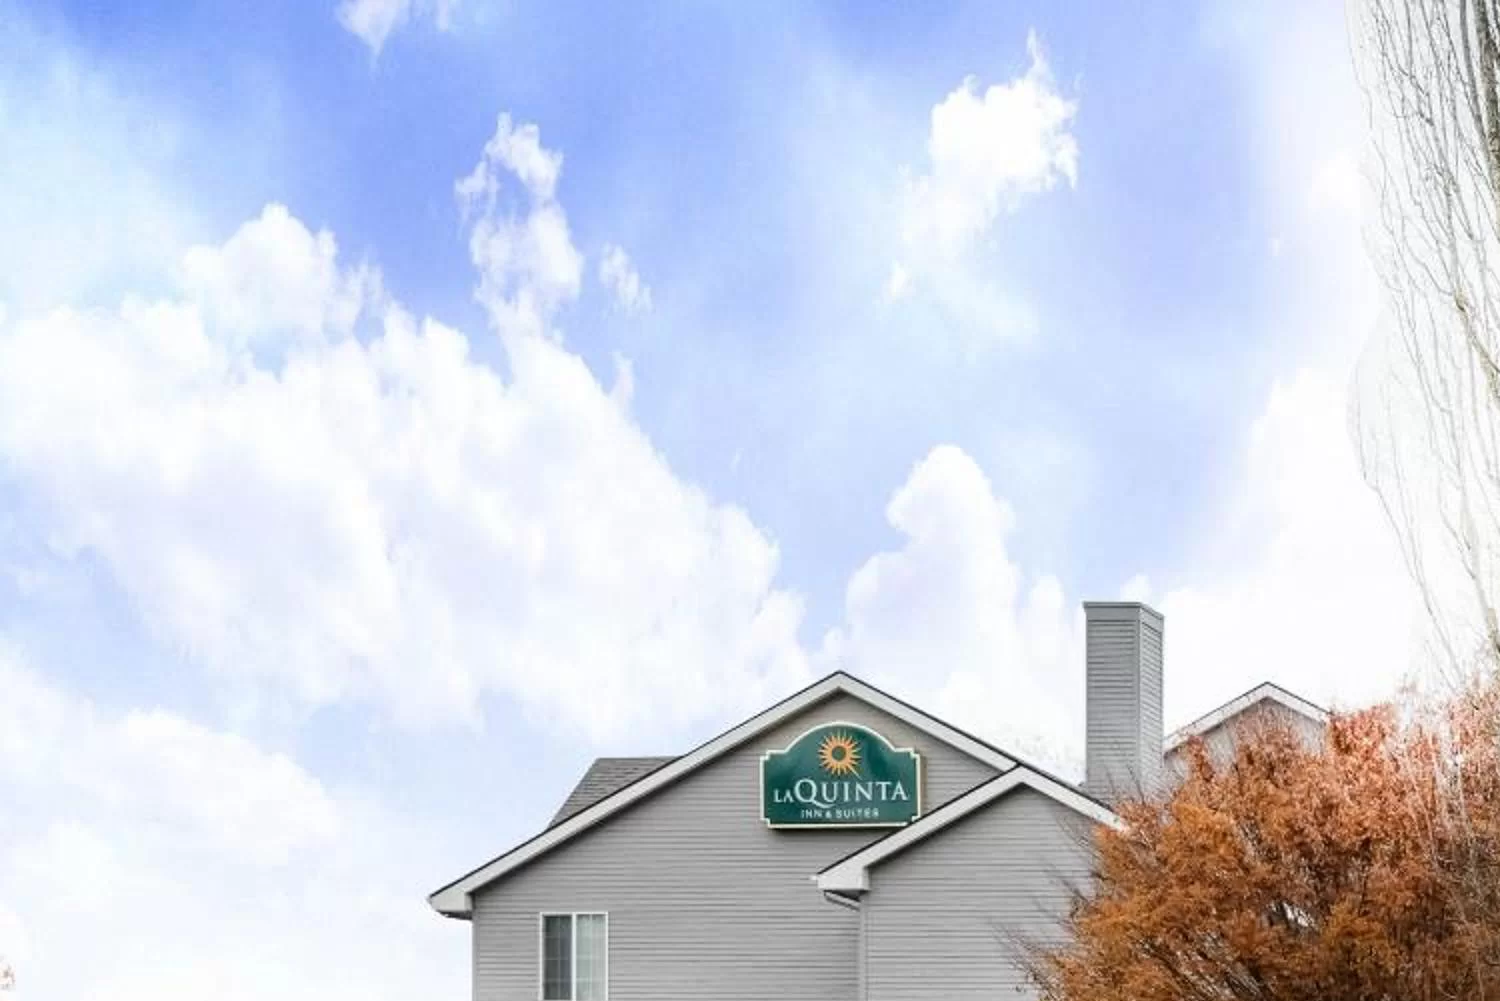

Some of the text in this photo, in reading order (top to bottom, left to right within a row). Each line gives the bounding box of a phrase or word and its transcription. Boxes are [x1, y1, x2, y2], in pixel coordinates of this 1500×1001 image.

[774, 777, 909, 809] LA QUINTA
[801, 809, 822, 819] INN
[835, 807, 880, 819] SUITES
